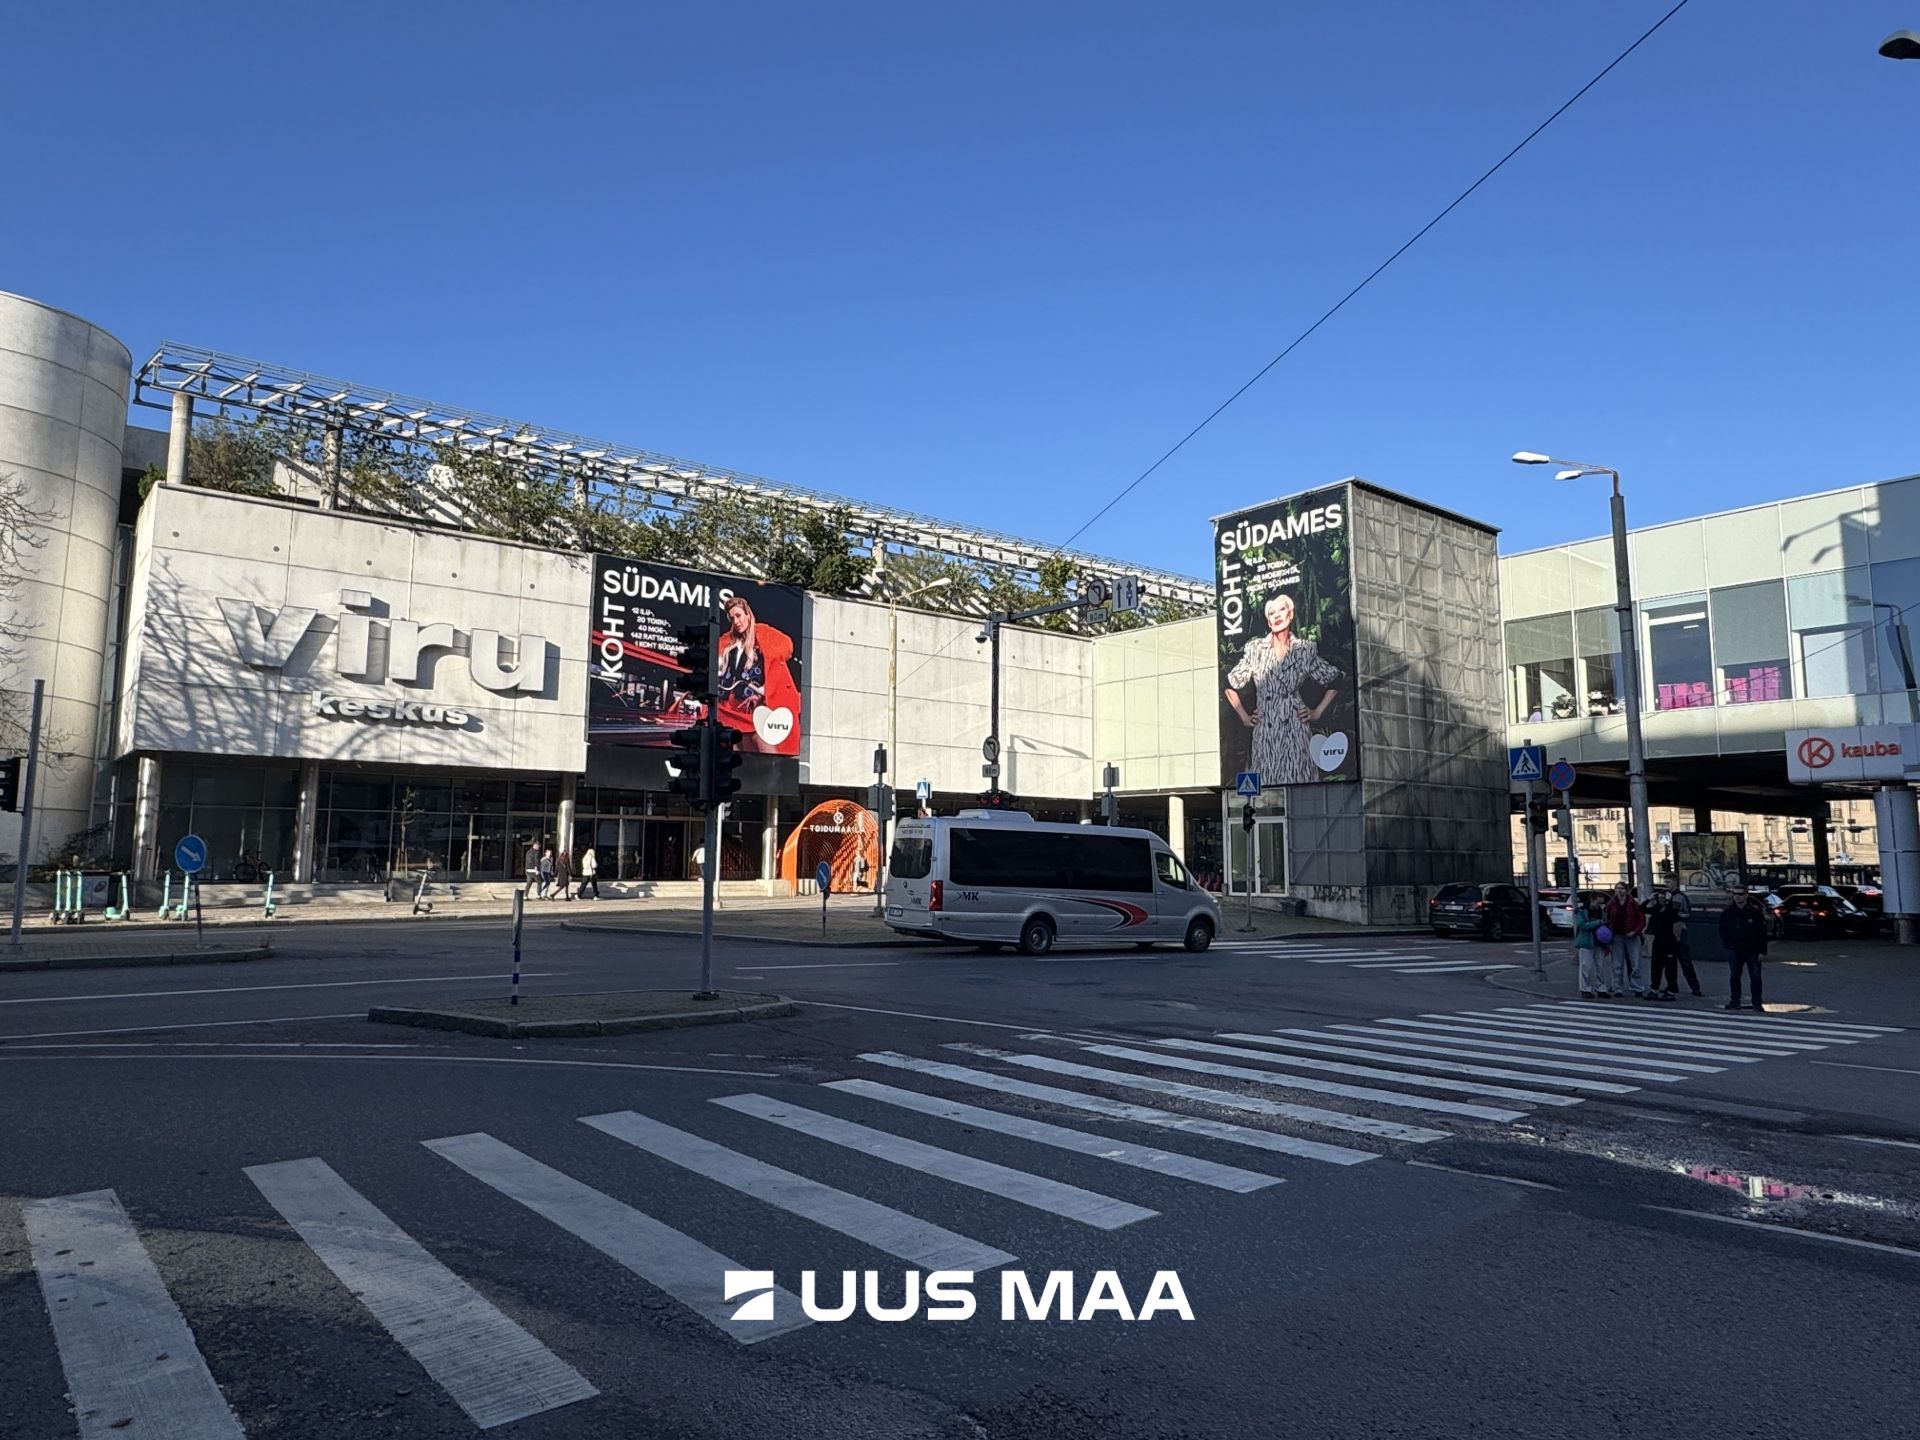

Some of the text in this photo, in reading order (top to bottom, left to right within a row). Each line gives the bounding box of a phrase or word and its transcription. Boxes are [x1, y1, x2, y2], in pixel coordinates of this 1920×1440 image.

[1221, 504, 1342, 555] SÜDAMES
[1222, 560, 1242, 636] KOHT
[216, 588, 546, 692] viru
[600, 596, 625, 679] KOHT
[630, 631, 643, 639] 142
[311, 690, 469, 725] keskus
[1323, 748, 1345, 756] viru
[1841, 740, 1902, 758] kauba
